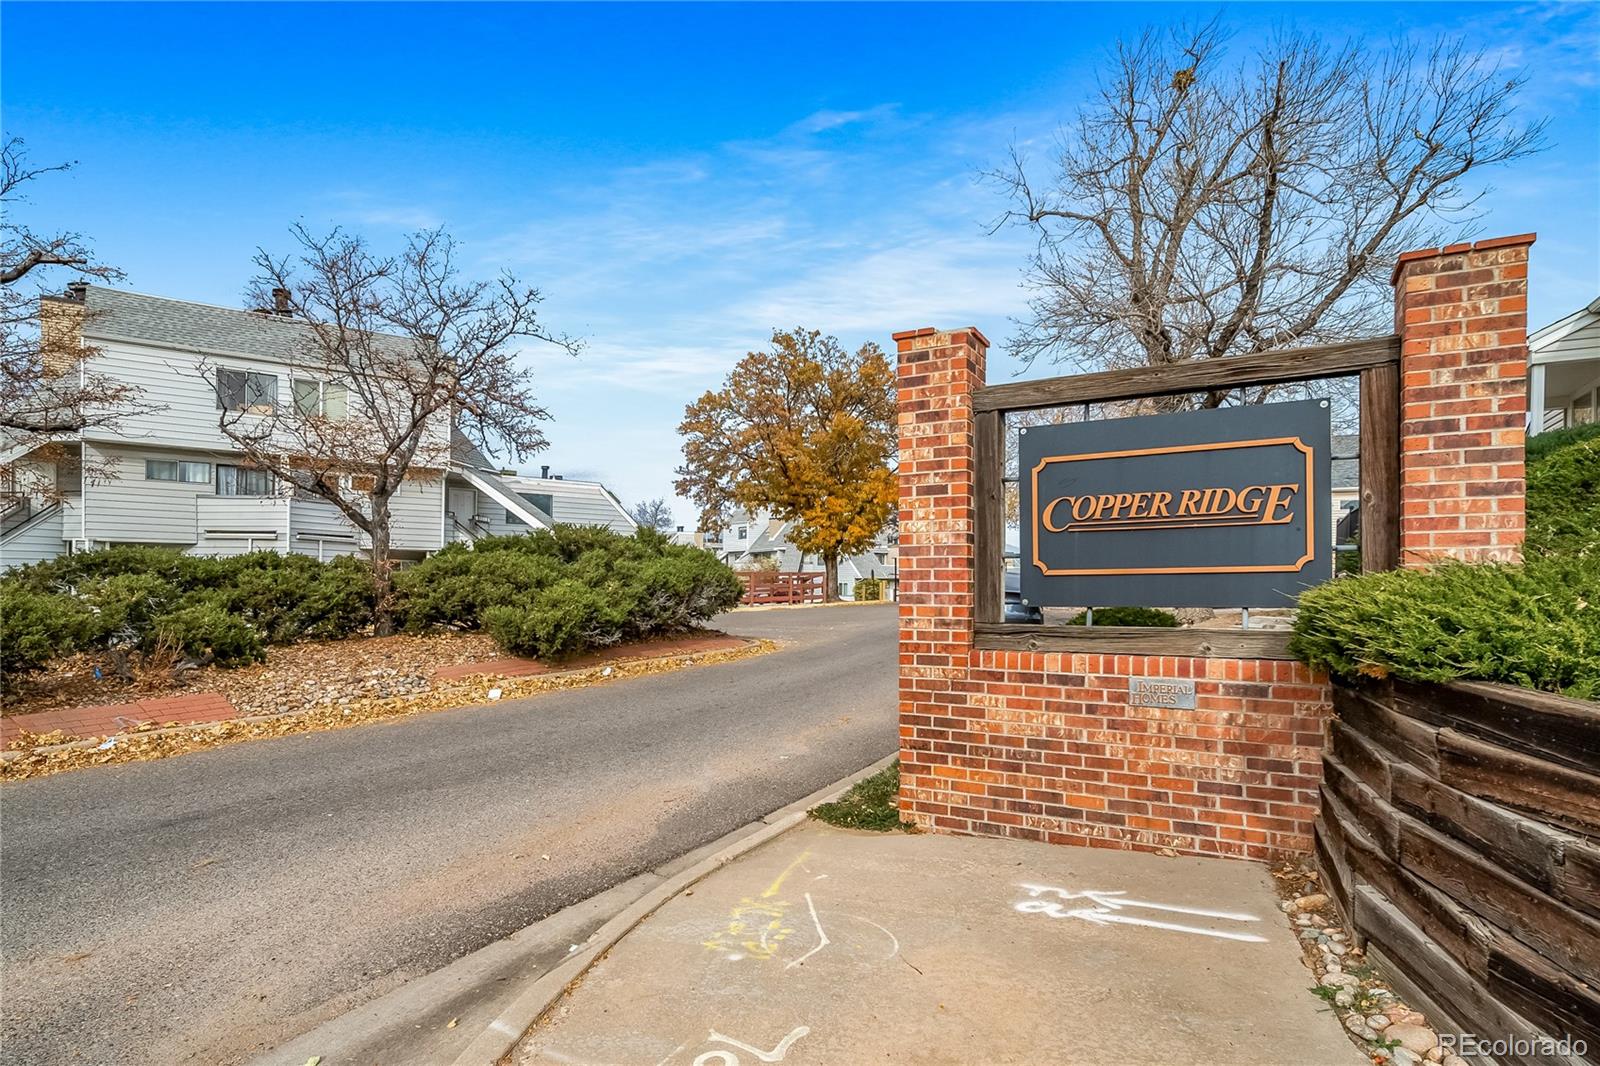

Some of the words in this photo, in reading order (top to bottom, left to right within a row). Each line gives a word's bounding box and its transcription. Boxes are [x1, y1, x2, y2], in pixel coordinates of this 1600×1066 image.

[1042, 491, 1173, 533] COPPER
[1175, 483, 1299, 524] RIDGE
[1136, 680, 1193, 695] IMPERIAL
[1131, 693, 1177, 705] HOMES
